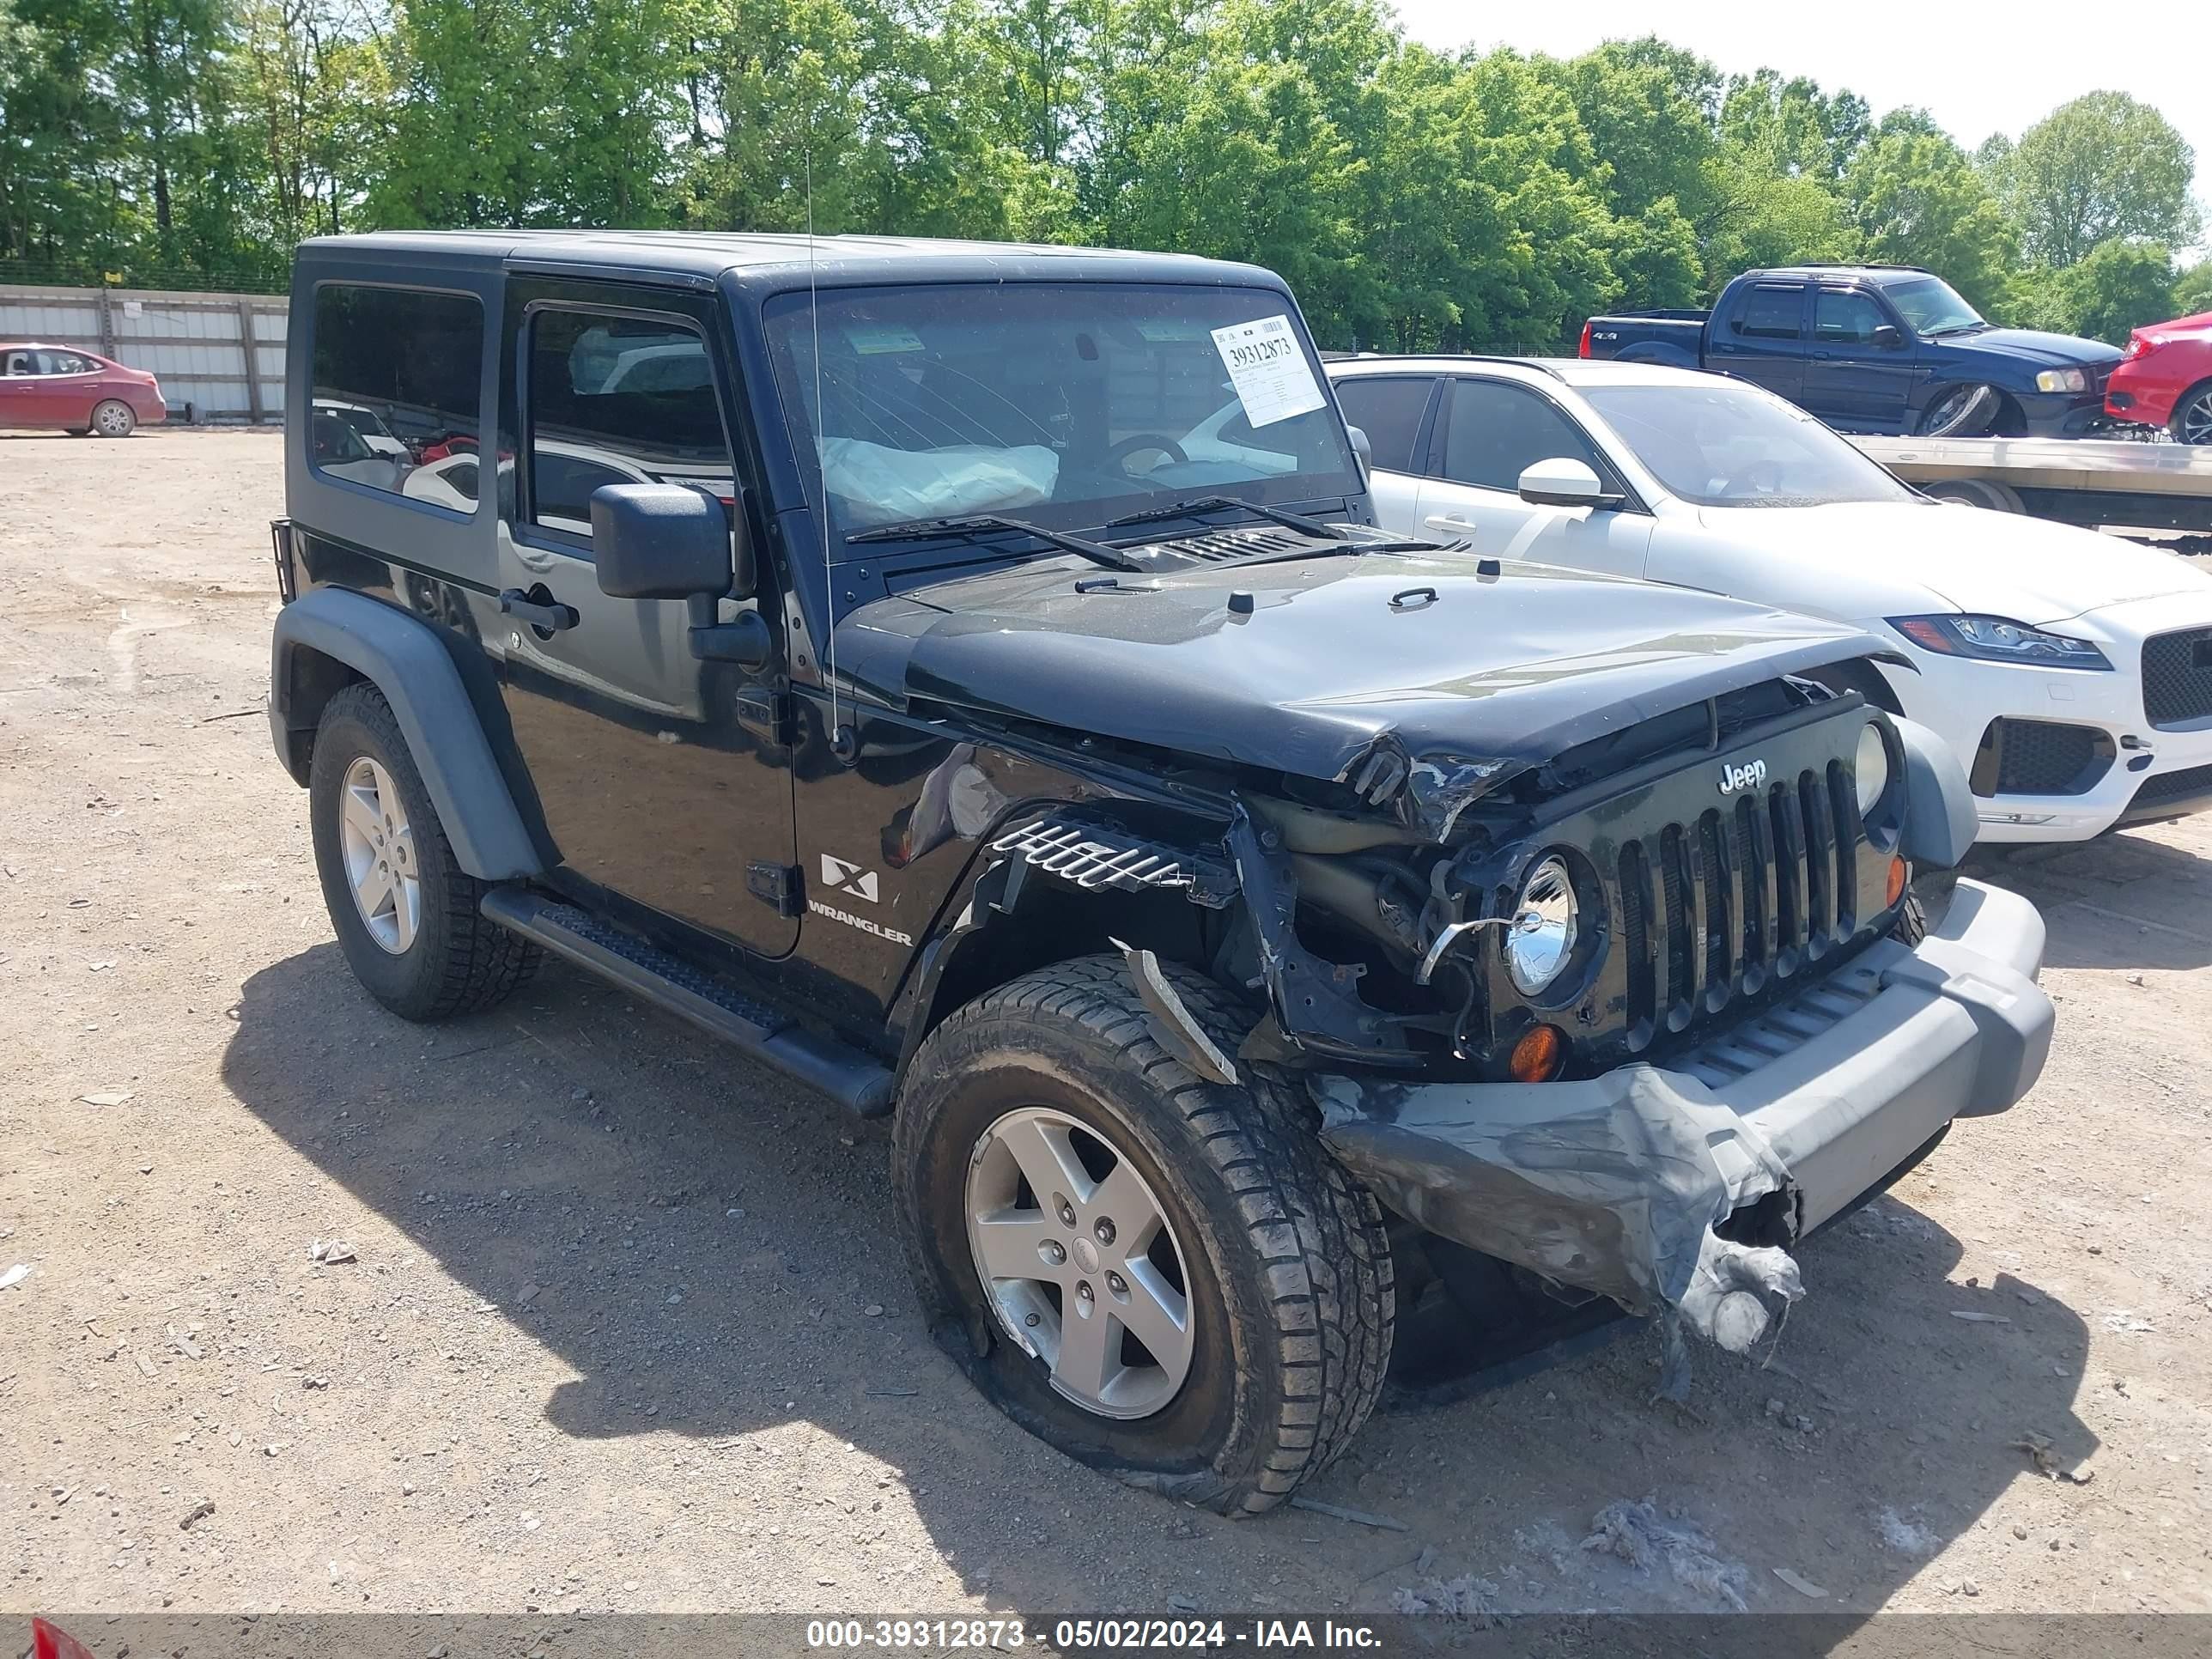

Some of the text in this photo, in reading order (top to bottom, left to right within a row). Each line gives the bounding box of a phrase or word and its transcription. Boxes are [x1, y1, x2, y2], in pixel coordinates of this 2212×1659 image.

[1230, 337, 1291, 367] 39312873
[1719, 759, 1766, 795] Jeep
[808, 899, 915, 947] WRANGLER
